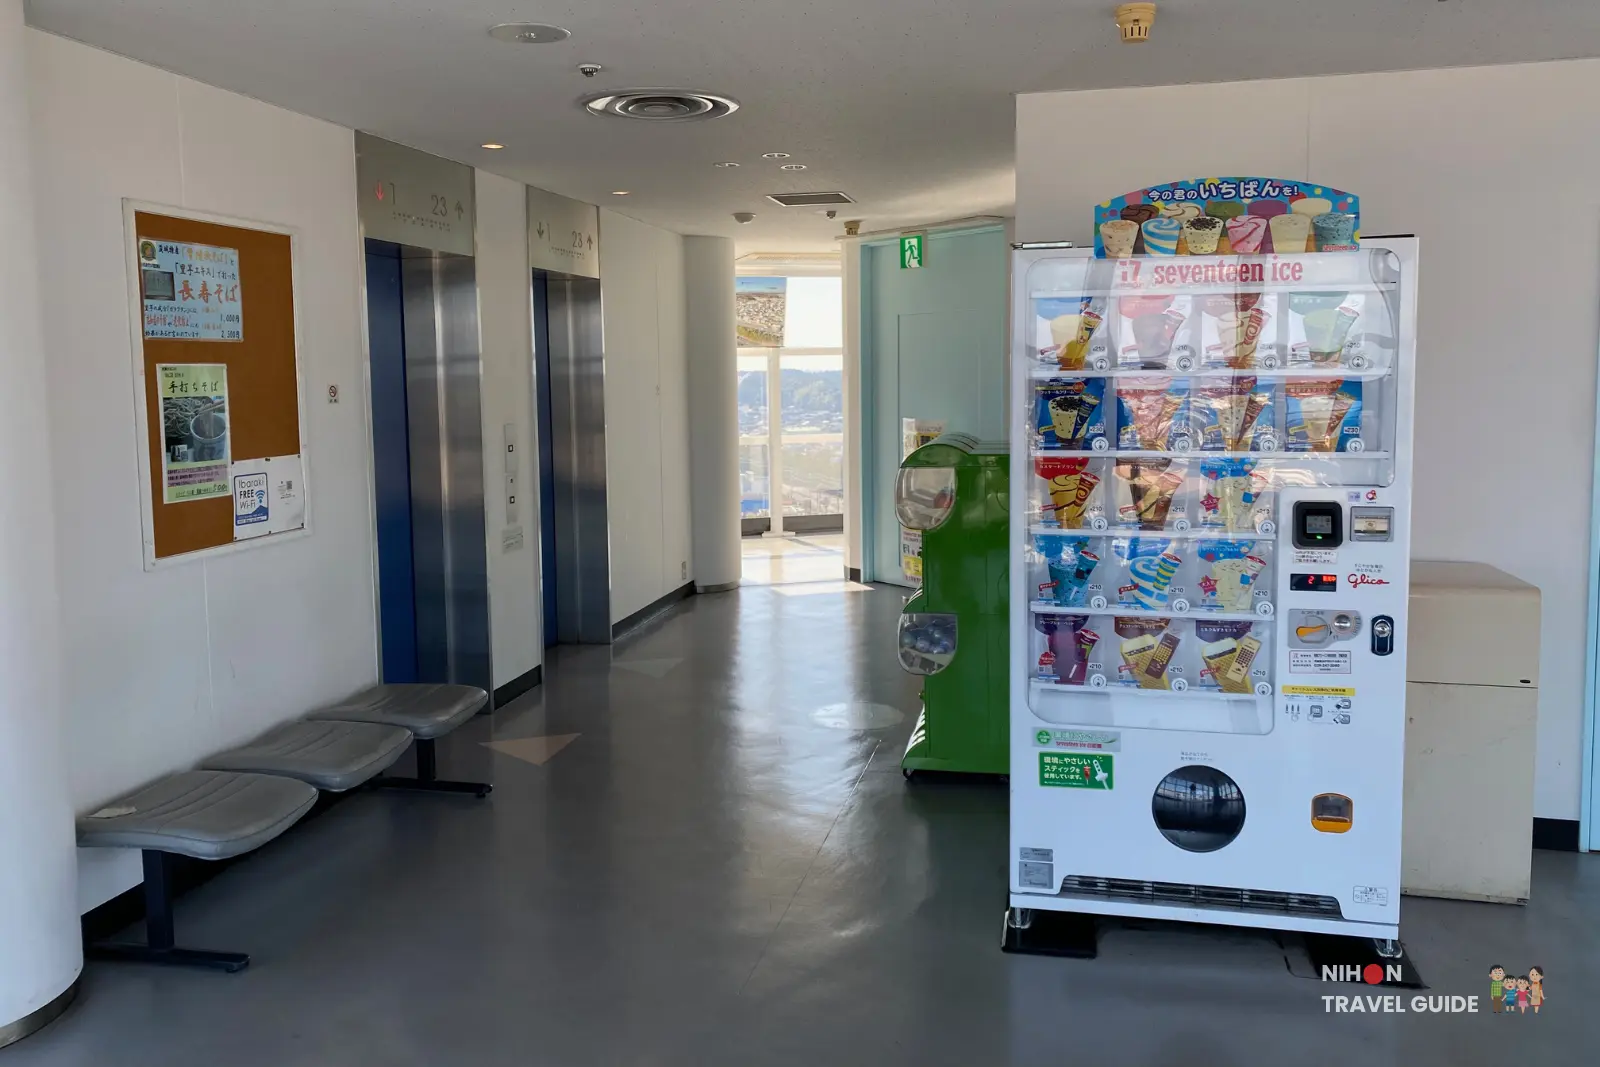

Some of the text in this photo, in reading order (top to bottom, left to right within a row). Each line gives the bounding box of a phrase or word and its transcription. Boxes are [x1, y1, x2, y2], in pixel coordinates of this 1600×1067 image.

[1148, 181, 1301, 204] 今の君のいちばんを!
[430, 194, 448, 217] 23
[571, 231, 584, 248] 23
[1154, 260, 1264, 284] seventeen
[1271, 255, 1304, 282] ice
[178, 280, 239, 304] 長寿そば
[168, 381, 219, 394] 手打ちそば
[238, 477, 264, 489] Ibaraki
[239, 489, 255, 500] FREE
[240, 499, 256, 510] Wi-Fi
[1347, 573, 1391, 589] Glico
[1044, 756, 1091, 765] 環境にやさしい
[1044, 765, 1081, 774] スティックを
[1044, 773, 1083, 781] 使用しています。
